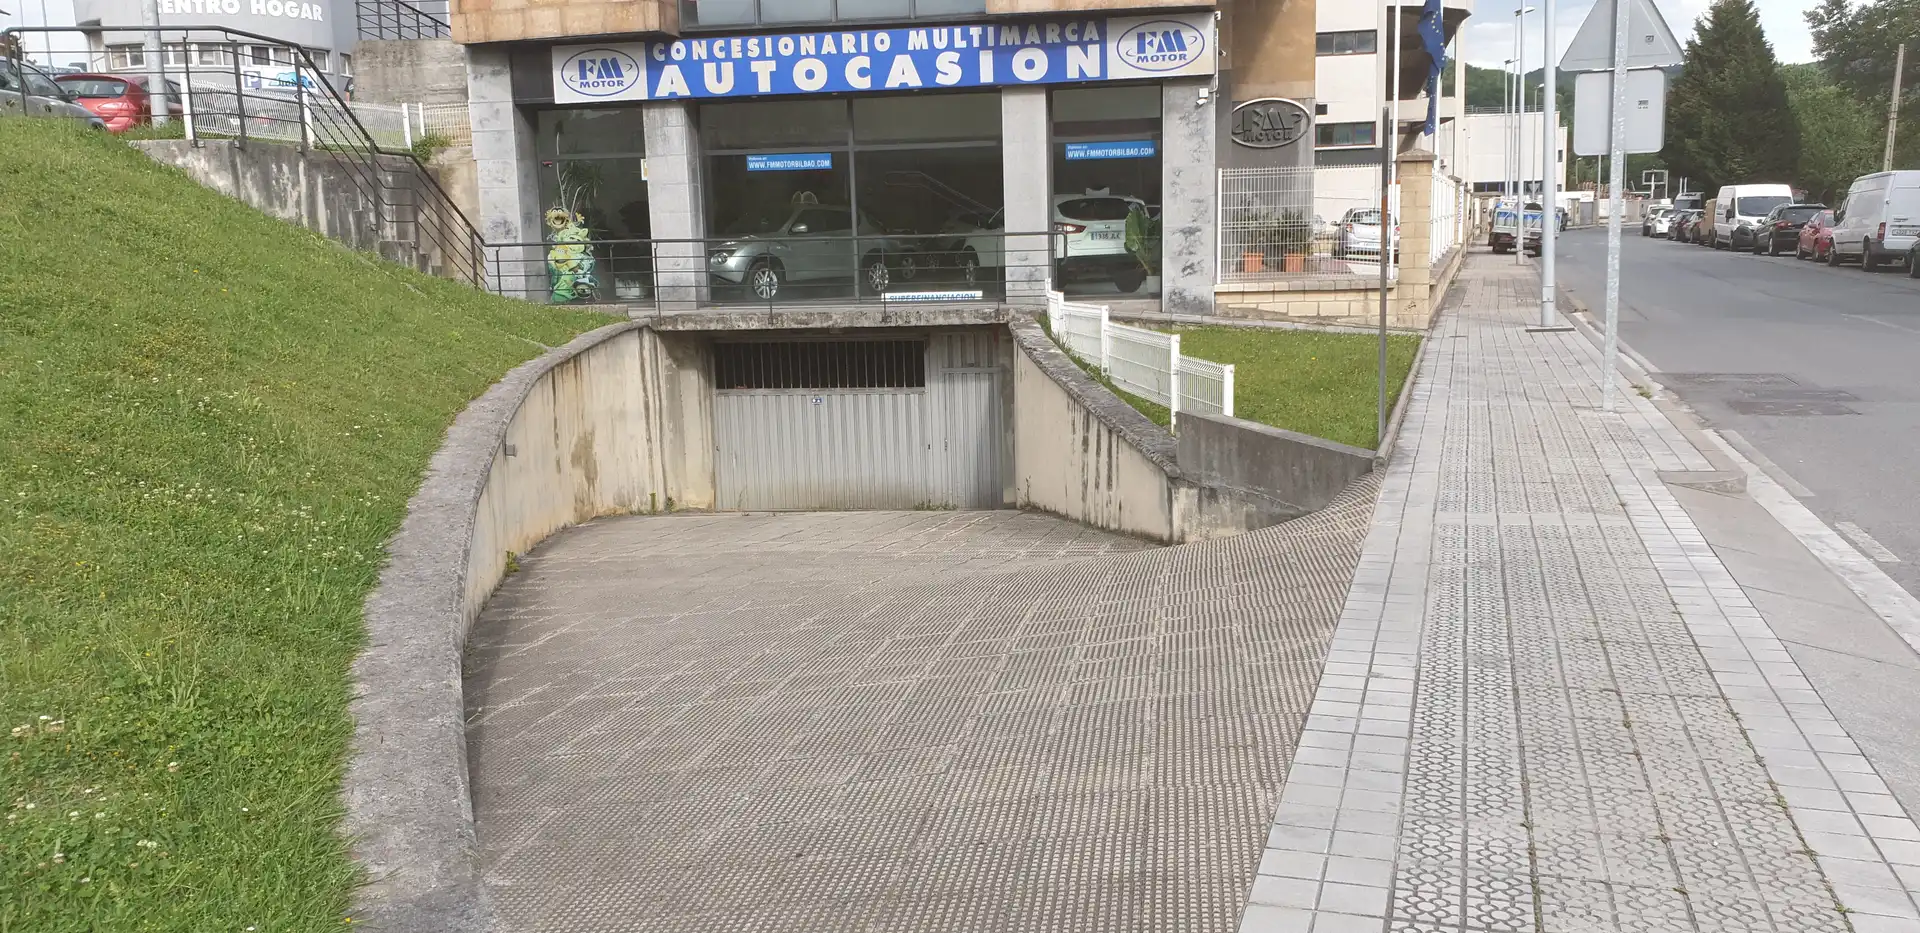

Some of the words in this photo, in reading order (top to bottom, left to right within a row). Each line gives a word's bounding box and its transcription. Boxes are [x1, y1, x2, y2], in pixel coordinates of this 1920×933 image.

[158, 0, 241, 15] ENTRO
[250, 0, 323, 22] HOGAR
[652, 32, 891, 62] CONCESIONARIO
[908, 21, 1100, 51] MULTIMARCA
[1136, 29, 1188, 54] FM
[577, 56, 625, 81] FM
[1136, 53, 1188, 64] MOTOR
[655, 44, 1101, 97] AUTOCASION
[579, 79, 625, 89] MOTOR
[1242, 108, 1294, 132] FM
[1243, 130, 1293, 143] MOTOR
[748, 159, 830, 169] WWW.FMMOTORBILBAO.COM
[1067, 147, 1155, 159] WWW.FMMOTORBILBAO.COM
